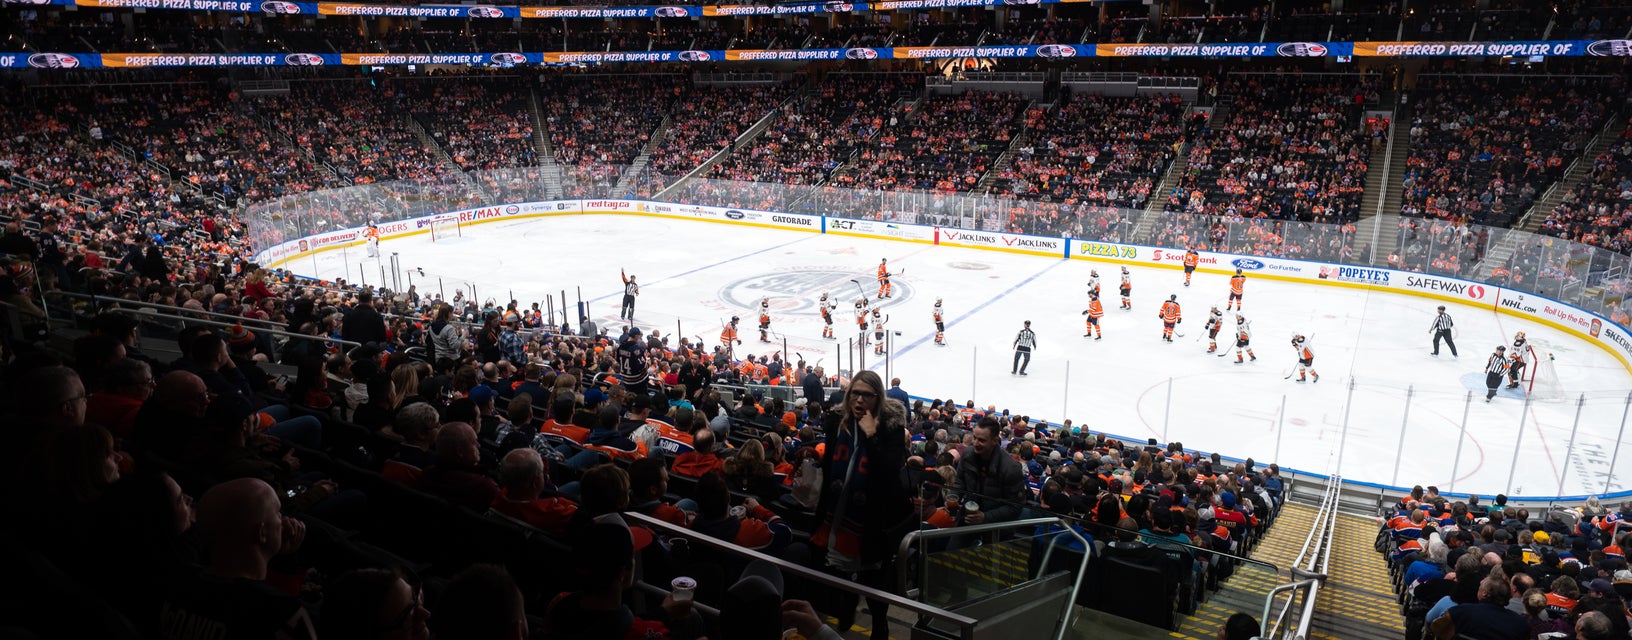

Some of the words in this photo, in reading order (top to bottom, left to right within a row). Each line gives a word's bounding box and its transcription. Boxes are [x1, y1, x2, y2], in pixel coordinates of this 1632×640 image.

[98, 0, 159, 8] PREFERRED
[163, 0, 191, 9] PIZZA
[194, 0, 237, 10] SUPPLIER
[882, 1, 920, 9] PREFERRED
[336, 6, 383, 14] PREFERRED
[386, 7, 407, 15] PIZZA
[410, 8, 447, 16] SUPPLIER
[449, 8, 459, 16] OF
[716, 7, 755, 15] PREFERRED
[908, 49, 950, 57] PREFERRED
[953, 49, 975, 57] PIZZA
[977, 48, 1014, 57] SUPPLIER
[1017, 48, 1027, 56] OF
[1115, 46, 1168, 55] PREFERRED
[1171, 46, 1198, 55] PIZZA
[1201, 46, 1249, 55] SUPPLIER
[1252, 46, 1266, 55] OF
[1377, 45, 1445, 55] PREFERRED
[1449, 45, 1484, 55] PIZZA
[1487, 44, 1550, 55] SUPPLIER
[1554, 44, 1572, 54] OF
[360, 56, 406, 64] PREFERRED
[408, 56, 430, 64] PIZZA
[433, 56, 470, 64] SUPPLIER
[473, 55, 482, 63] OF
[559, 54, 601, 62] PREFERRED
[779, 51, 796, 59] PIZZA
[828, 51, 838, 59] OF
[1, 56, 15, 66] OF
[126, 56, 185, 66] PREFERRED
[189, 56, 216, 65] PIZZA
[219, 56, 260, 64] SUPPLIER
[262, 56, 275, 64] OF
[460, 208, 501, 222] RE/MAX
[772, 215, 812, 225] GATORADE
[378, 223, 408, 234] OGERS
[330, 233, 356, 241] DELIVERY
[958, 233, 975, 242] JACK
[1017, 239, 1035, 248] JACK
[1081, 243, 1119, 257] PIZZA
[1120, 246, 1137, 258] 73
[1165, 253, 1217, 264] Scotank
[1236, 259, 1259, 270] Ford
[1339, 267, 1390, 282] POPEYE'S
[1406, 276, 1467, 294] SAFEWAY
[1544, 305, 1558, 316] Roll
[1557, 309, 1567, 319] Up
[1567, 314, 1578, 323] the
[1578, 318, 1590, 328] Rim
[620, 356, 631, 375] 14
[1579, 442, 1610, 466] THE
